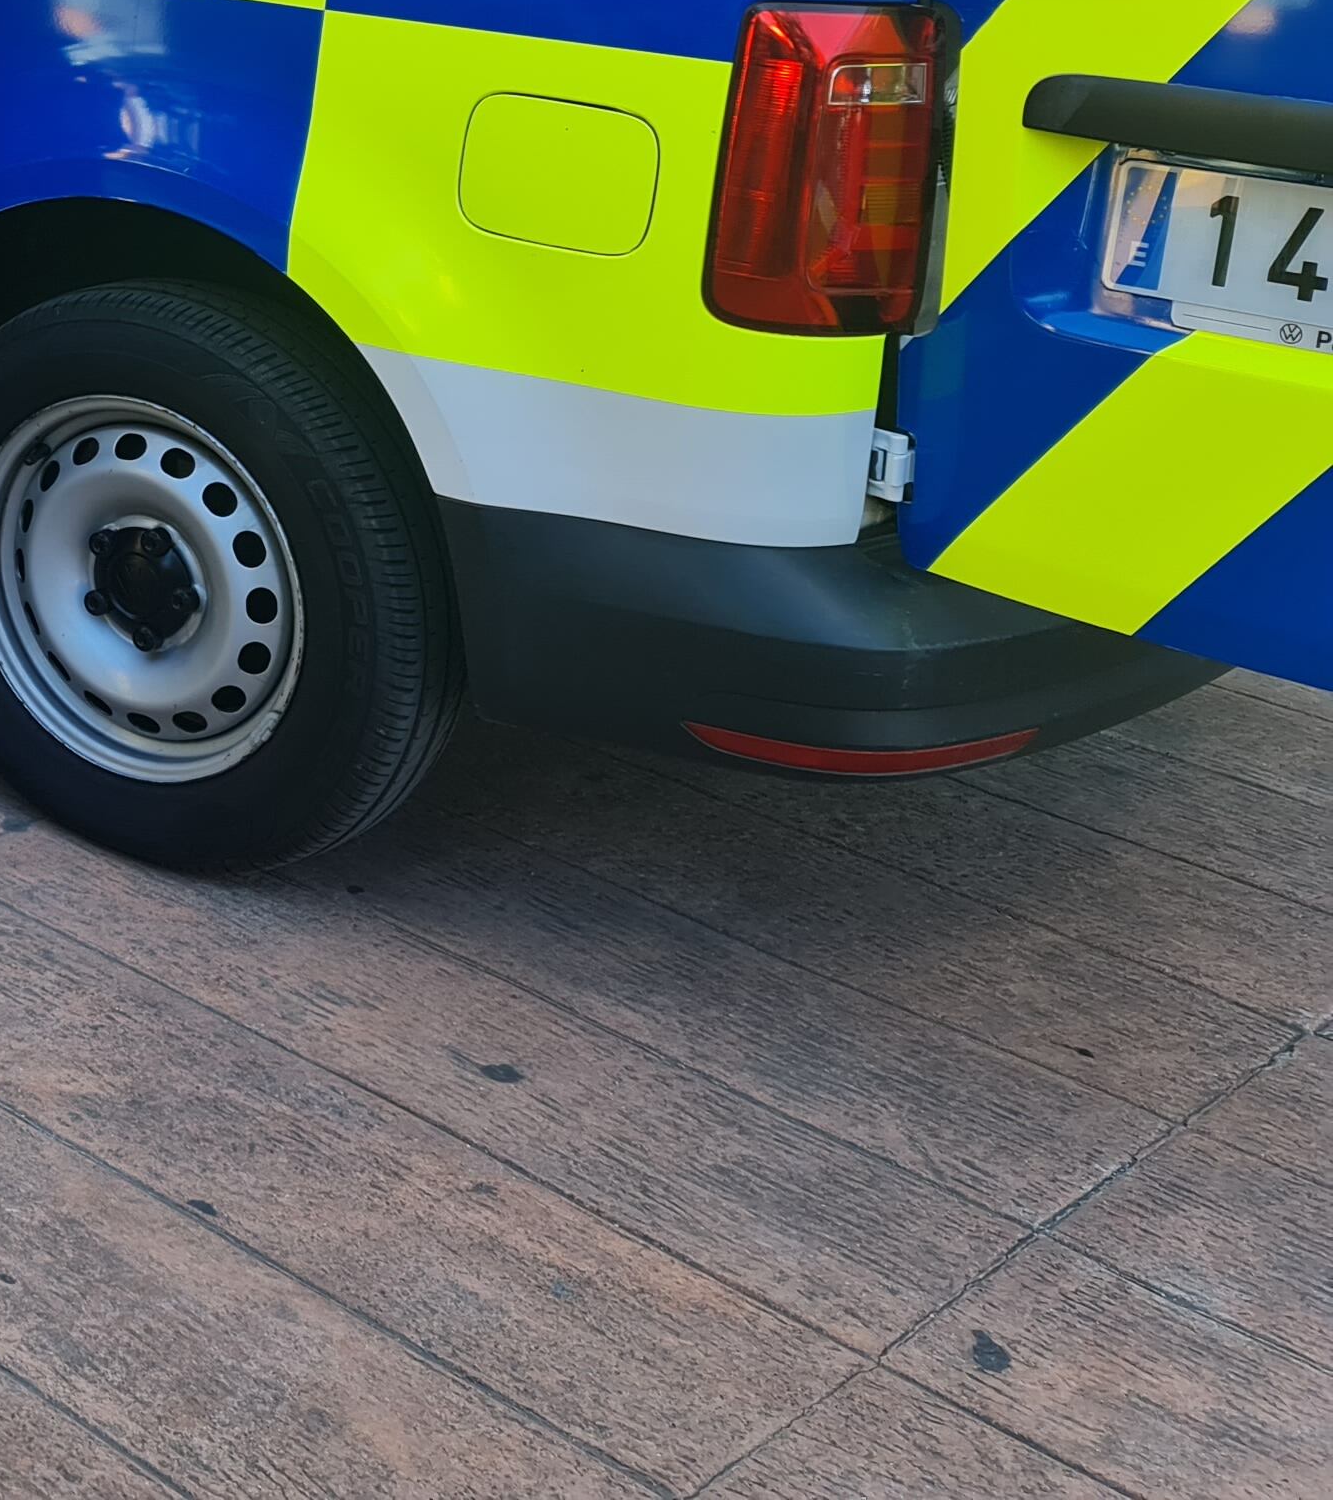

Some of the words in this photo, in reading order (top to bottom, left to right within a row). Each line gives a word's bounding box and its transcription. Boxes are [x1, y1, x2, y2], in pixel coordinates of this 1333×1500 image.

[1128, 240, 1149, 267] E
[1209, 195, 1329, 302] 14
[1316, 330, 1333, 349] P
